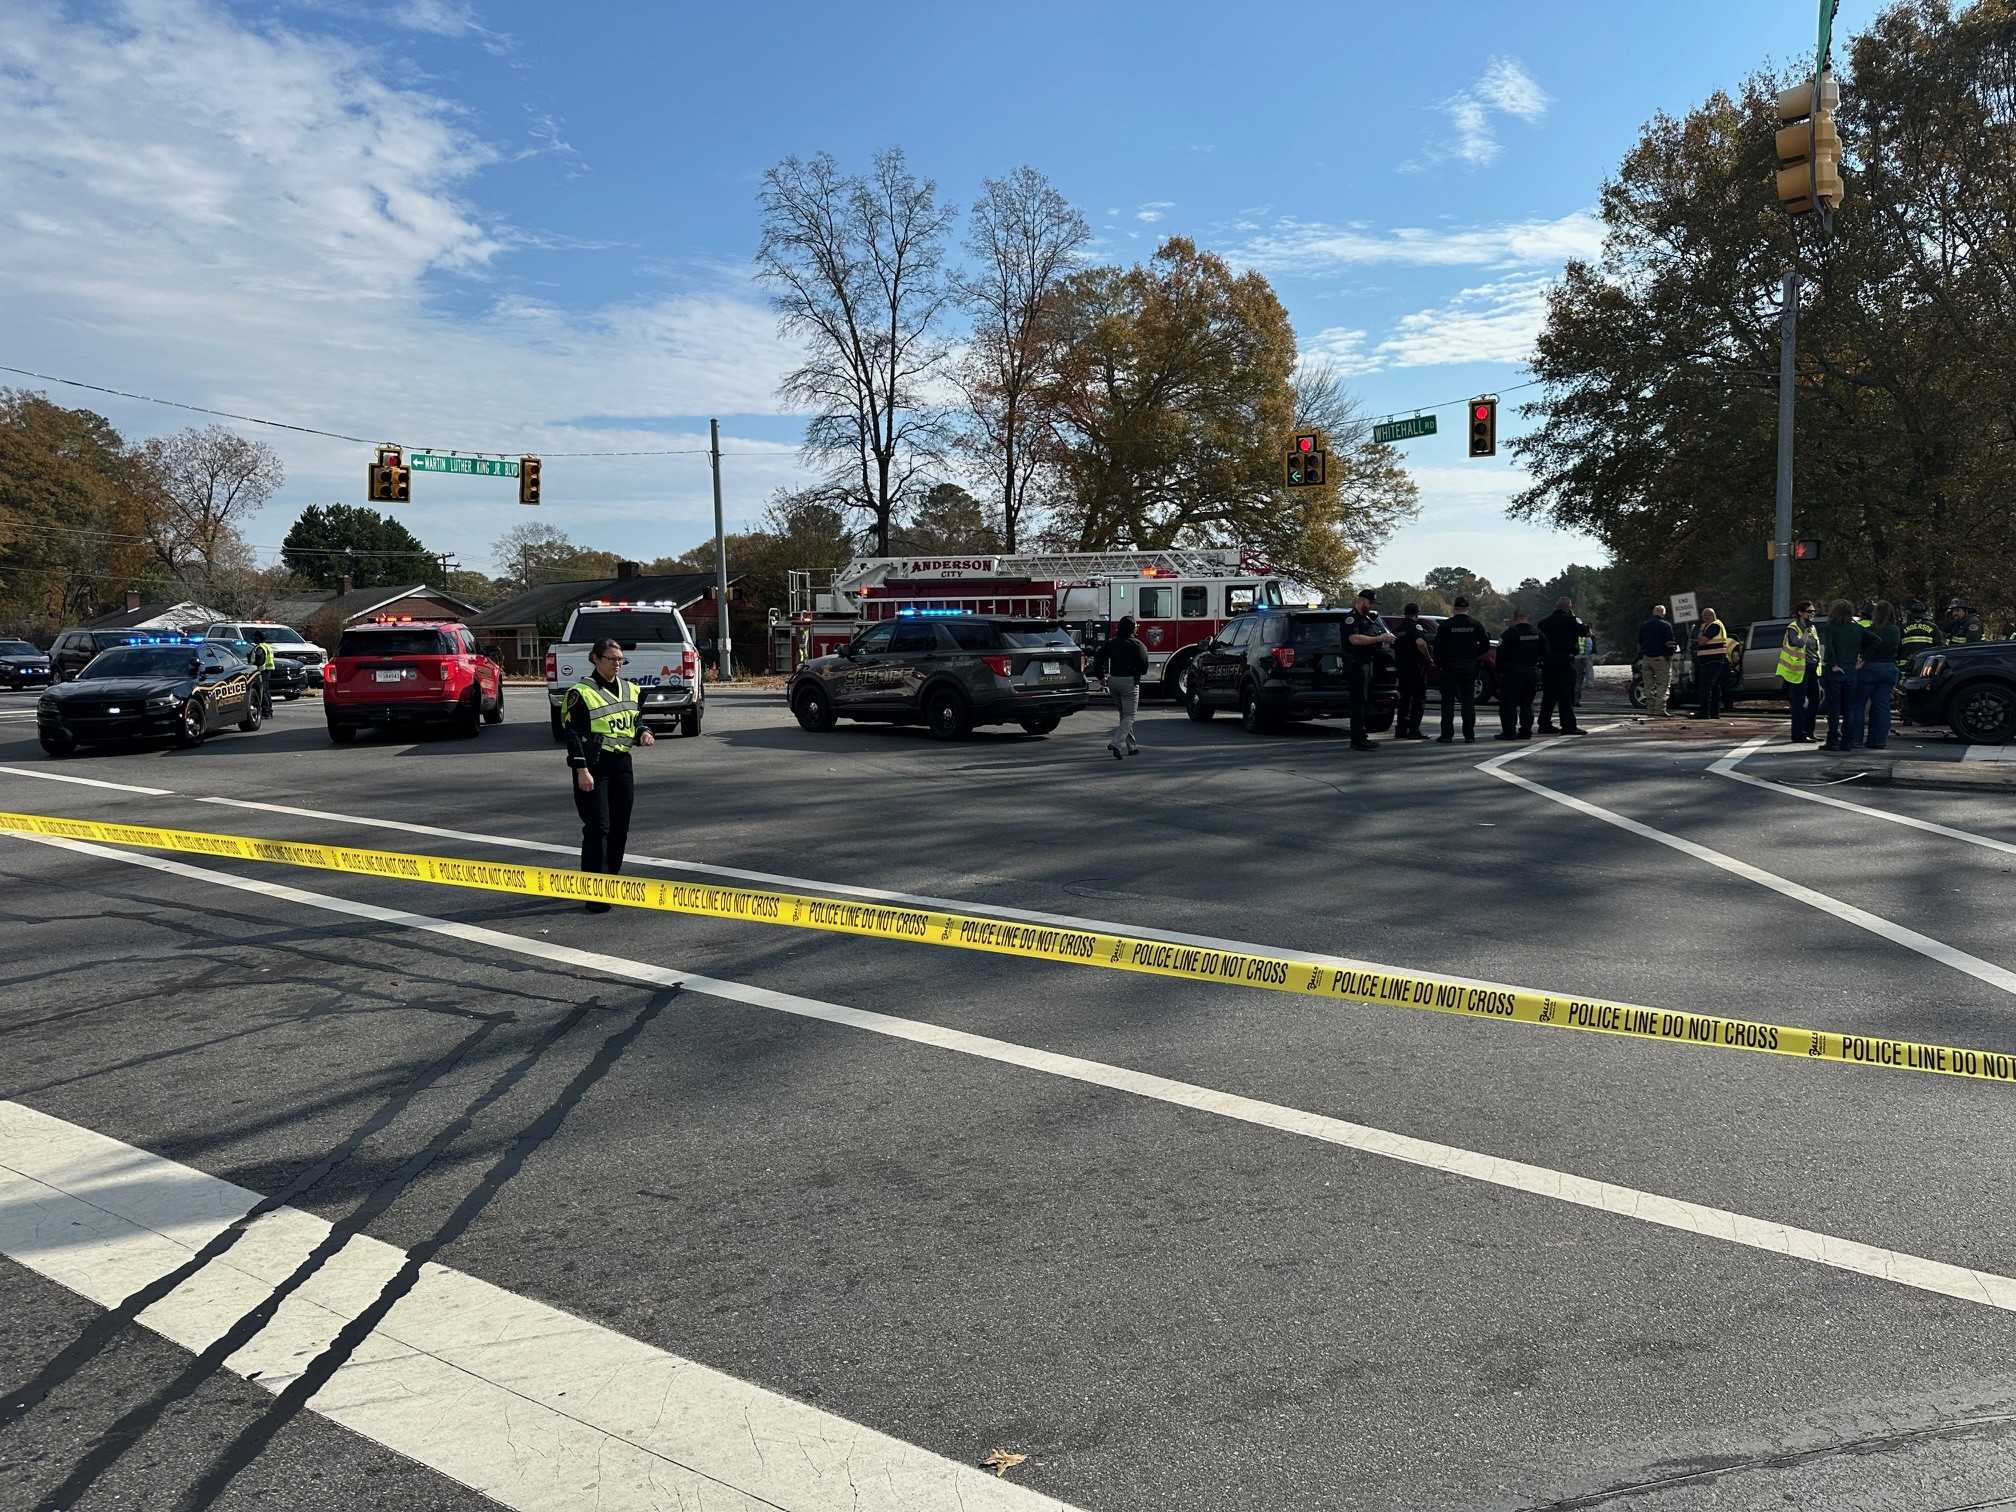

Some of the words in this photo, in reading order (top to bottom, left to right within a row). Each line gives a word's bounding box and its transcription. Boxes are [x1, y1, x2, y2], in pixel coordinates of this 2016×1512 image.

[1375, 420, 1424, 441] WHITEHALL
[425, 457, 445, 471] MARTIN
[450, 458, 472, 472] LUTHER
[476, 460, 490, 474] KING
[504, 462, 518, 476] BLVD
[910, 560, 992, 573] ANDERSON
[942, 570, 962, 578] CITY
[214, 682, 246, 698] POLICE
[440, 863, 461, 881] POLICE
[461, 865, 476, 882] LINE
[478, 867, 488, 884] DO
[489, 868, 502, 885] NOT
[503, 869, 527, 888] CROSS
[550, 874, 574, 893] POLICE
[577, 877, 592, 895] LINE
[593, 878, 603, 897] DO
[605, 880, 620, 898] NOT
[621, 881, 646, 901] CROSS
[673, 887, 700, 908] POLICE
[702, 890, 718, 910] LINE
[721, 893, 732, 912] DO
[734, 894, 752, 914] NOT
[752, 896, 780, 917] CROSS
[809, 902, 840, 924] POLICE
[841, 906, 862, 928] LINE
[862, 909, 875, 928] DO
[876, 910, 897, 931] NOT
[897, 912, 928, 936] CROSS
[960, 921, 997, 944] POLICE
[996, 925, 1020, 948] LINE
[1019, 929, 1036, 949] DO
[1037, 932, 1059, 952] NOT
[1059, 934, 1095, 957] CROSS
[1132, 943, 1173, 968] POLICE
[1173, 949, 1201, 972] LINE
[1201, 953, 1219, 974] DO
[1220, 955, 1247, 978] NOT
[1247, 958, 1288, 984] CROSS
[1332, 971, 1379, 997] POLICE
[1381, 977, 1411, 1001] LINE
[1414, 982, 1433, 1005] DO
[1436, 986, 1465, 1008] NOT
[1468, 989, 1515, 1015] CROSS
[1568, 1003, 1620, 1030] POLICE
[1624, 1009, 1658, 1034] LINE
[1662, 1015, 1683, 1038] DO
[1689, 1018, 1720, 1042] NOT
[1725, 1022, 1778, 1049] CROSS
[1842, 1037, 1902, 1065] POLICE
[1908, 1045, 1945, 1071] LINE
[1953, 1051, 1976, 1074] DO
[1984, 1054, 2016, 1080] NOT
